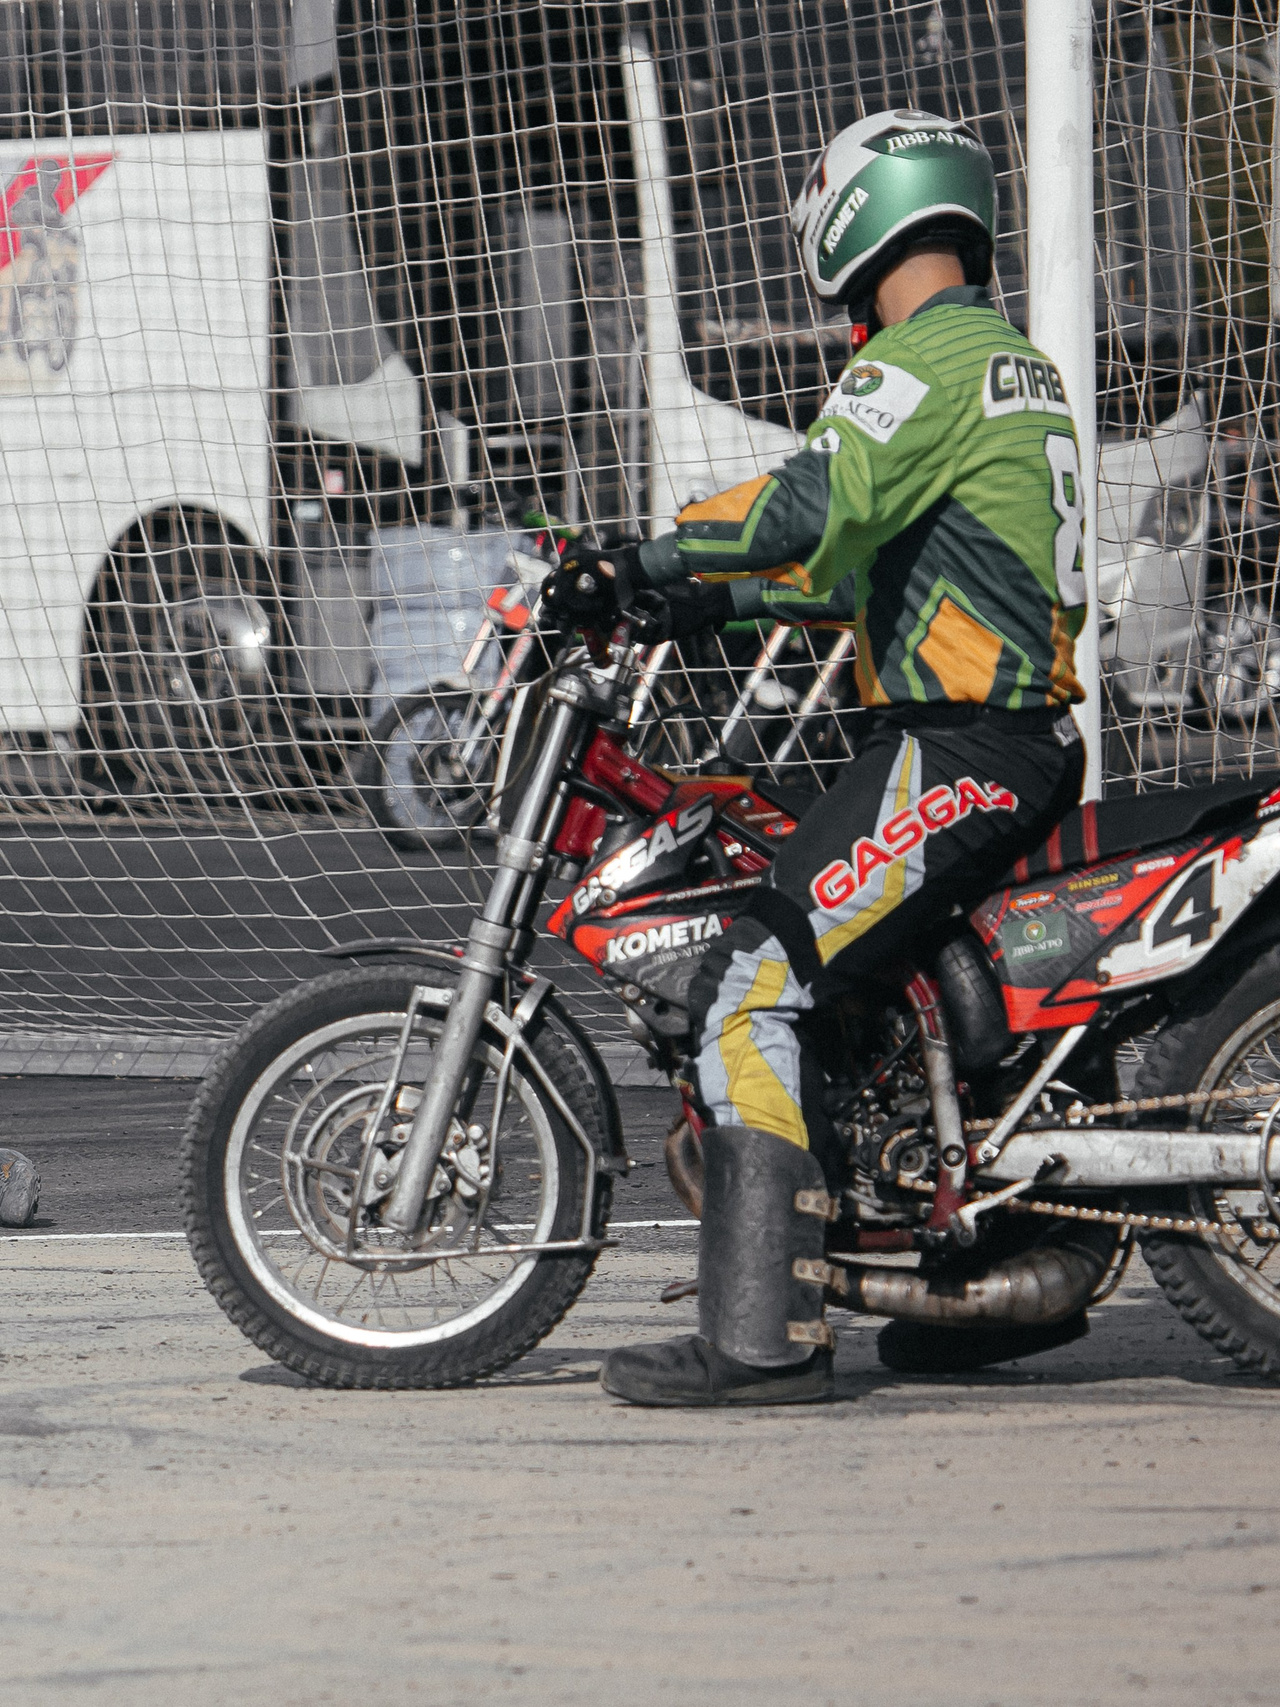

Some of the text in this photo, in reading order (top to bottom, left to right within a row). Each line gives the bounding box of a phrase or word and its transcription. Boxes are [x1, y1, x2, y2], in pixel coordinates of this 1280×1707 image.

[572, 793, 714, 915] GASGAS
[810, 776, 1019, 911] GASGAS
[1151, 855, 1221, 952] 4
